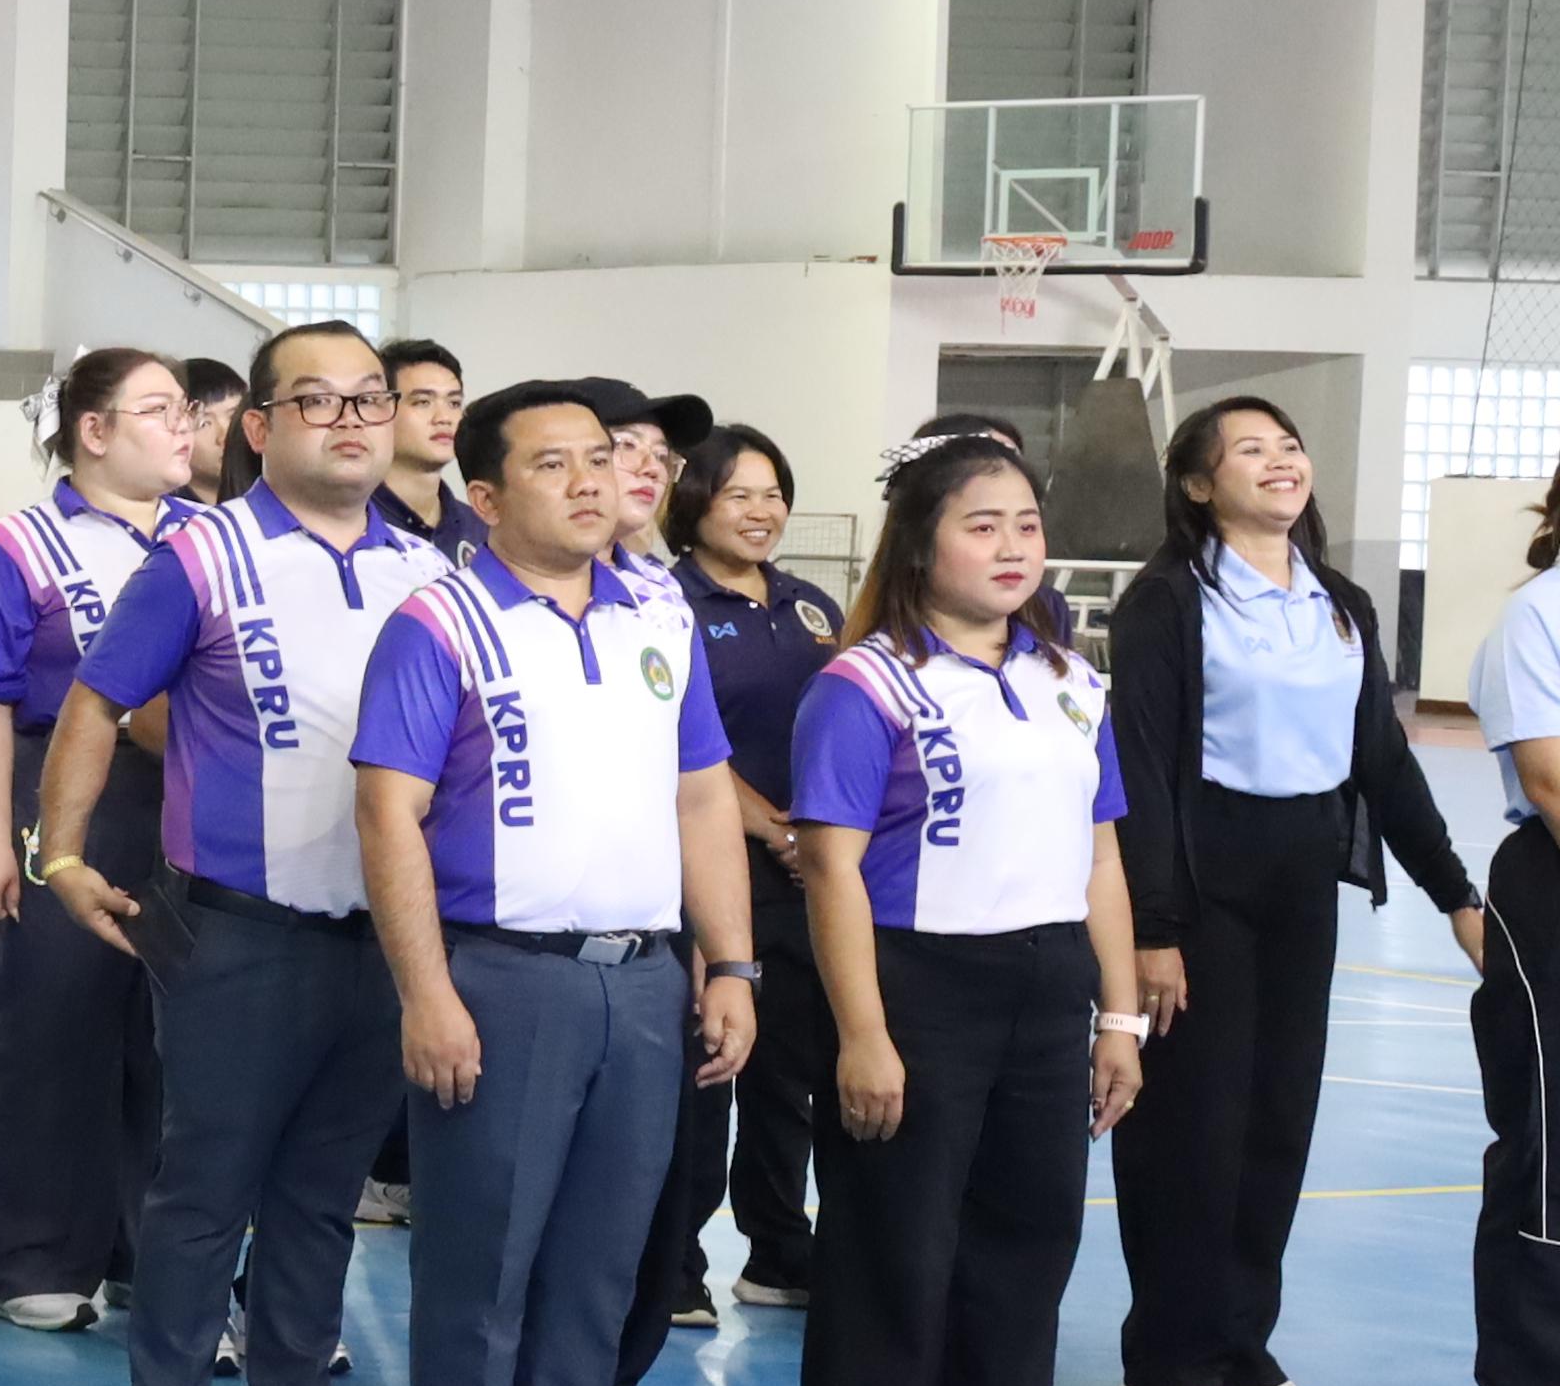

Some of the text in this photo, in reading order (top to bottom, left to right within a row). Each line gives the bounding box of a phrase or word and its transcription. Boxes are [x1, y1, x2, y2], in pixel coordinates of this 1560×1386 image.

[239, 618, 299, 749] KPRU
[486, 690, 534, 827] KPRU
[918, 725, 965, 846] KPRU
